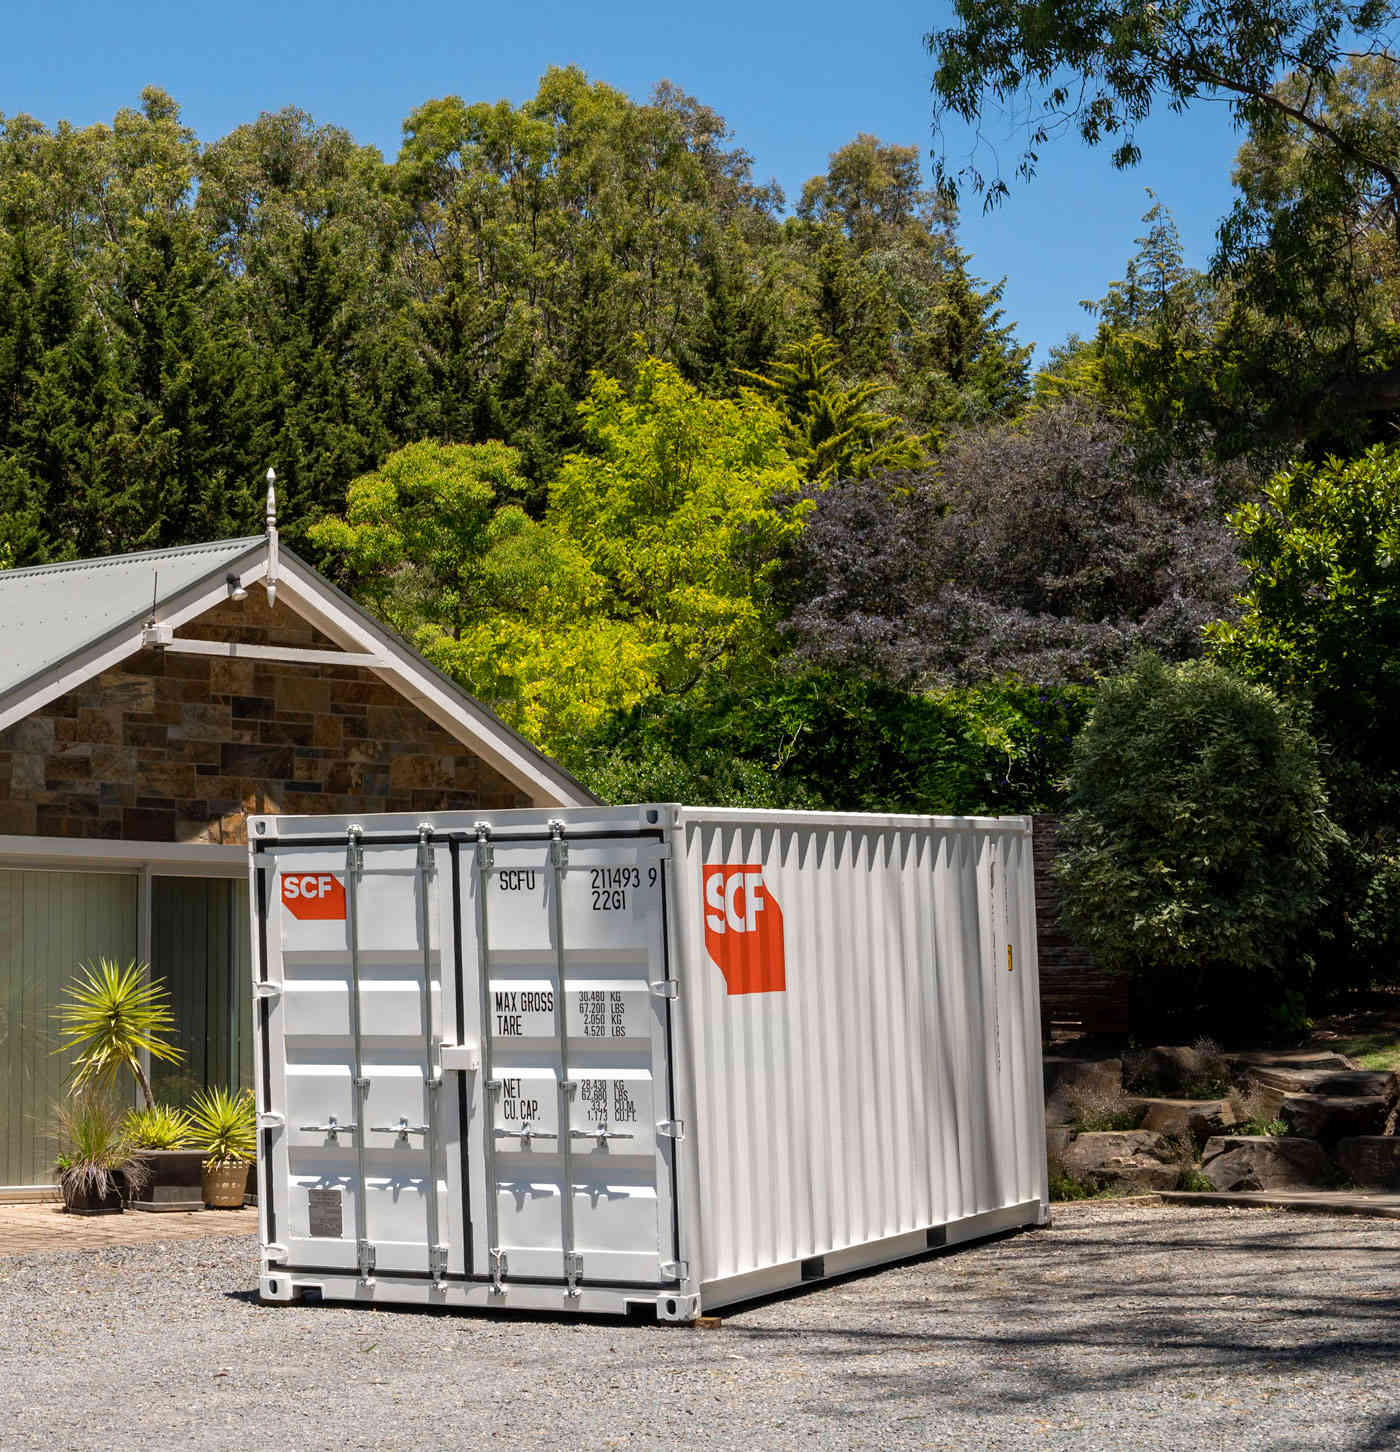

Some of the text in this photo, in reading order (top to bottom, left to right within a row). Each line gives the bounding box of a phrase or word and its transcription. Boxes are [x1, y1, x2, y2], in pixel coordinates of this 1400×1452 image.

[284, 877, 332, 898] SCF
[500, 868, 657, 890] SCFU 211493 9
[592, 890, 626, 910] 22G1
[706, 872, 764, 934] SCF
[496, 992, 553, 1012] MAX GROSS
[610, 991, 621, 1002] KG
[611, 1003, 625, 1014] LBS
[497, 1015, 522, 1035] TARE
[612, 1014, 622, 1025] KG
[612, 1026, 626, 1037] LBS
[503, 1078, 521, 1098] NET
[614, 1079, 625, 1090] KG
